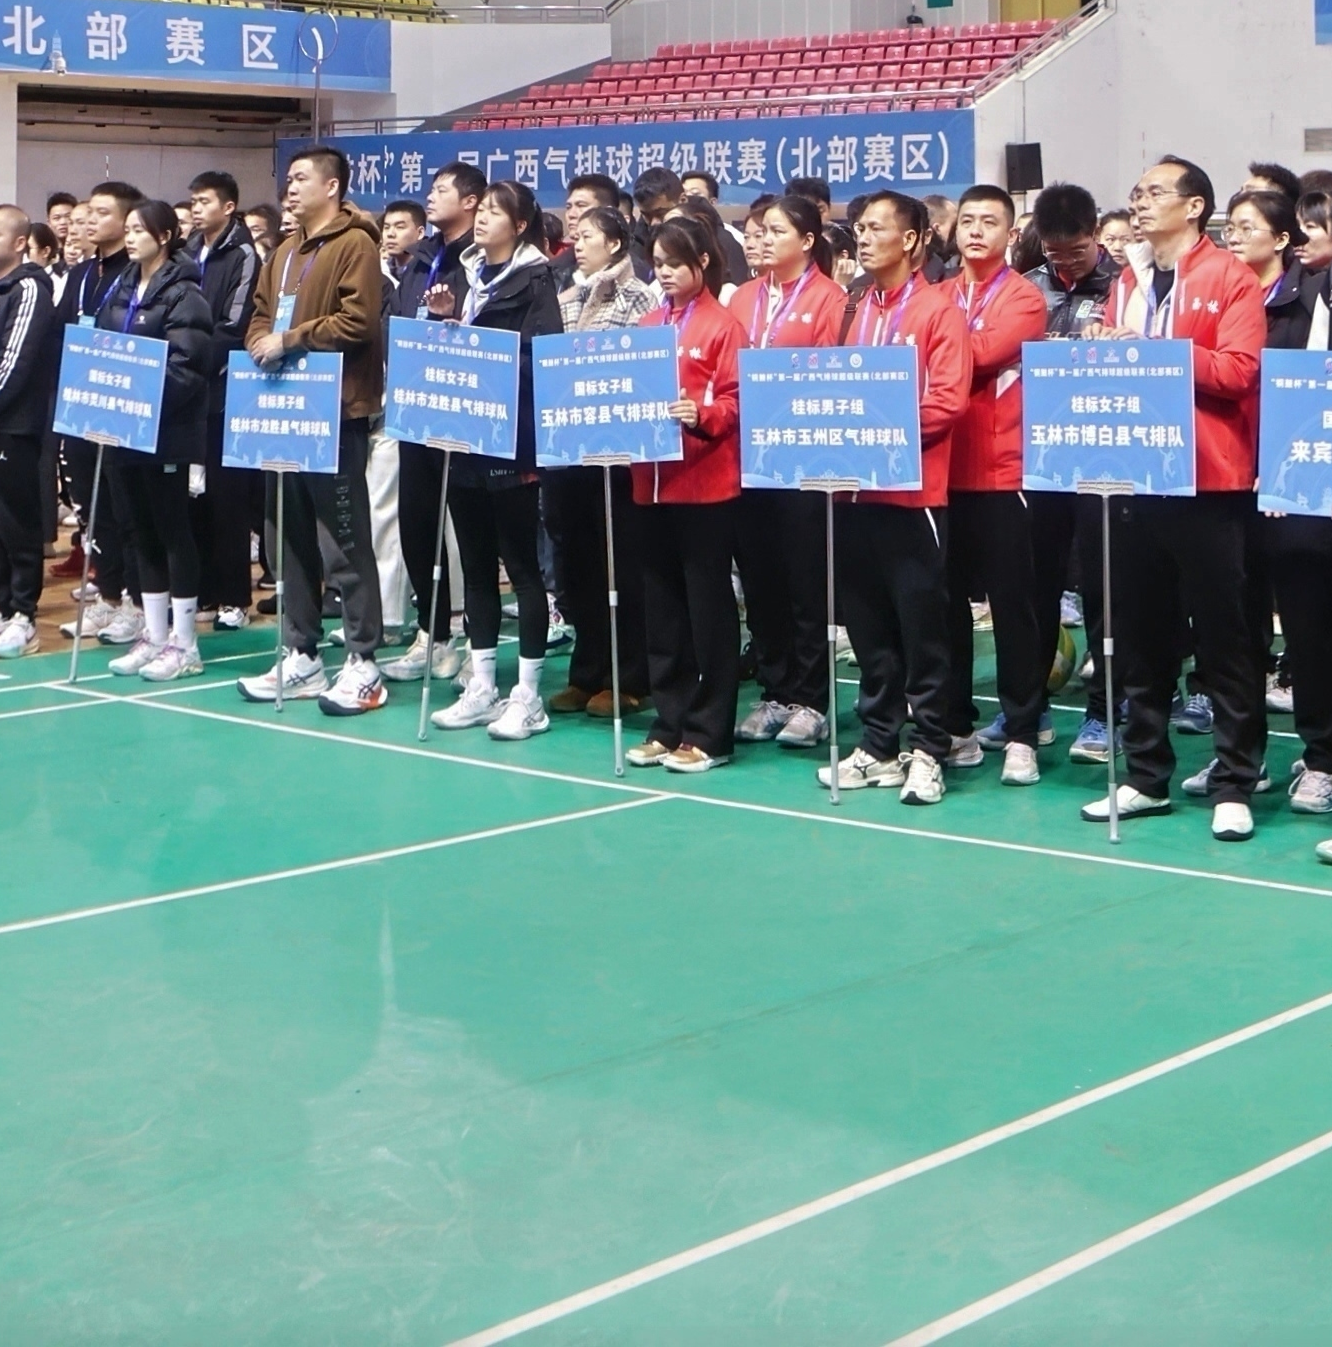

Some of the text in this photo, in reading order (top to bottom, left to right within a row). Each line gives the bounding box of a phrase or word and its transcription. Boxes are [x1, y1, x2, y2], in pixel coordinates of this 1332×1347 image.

[425, 366, 478, 389] 桂标女子组
[574, 378, 633, 397] 国标女子组
[393, 387, 508, 421] 桂林市龙胜县气排球队
[541, 401, 672, 428] 玉林市容县气排球队
[791, 399, 865, 416] 桂标男子组
[1071, 395, 1141, 414] 桂标女子组
[751, 428, 908, 446] 玉林市玉州区气排球队
[1031, 424, 1185, 448] 玉林市博白县气排队
